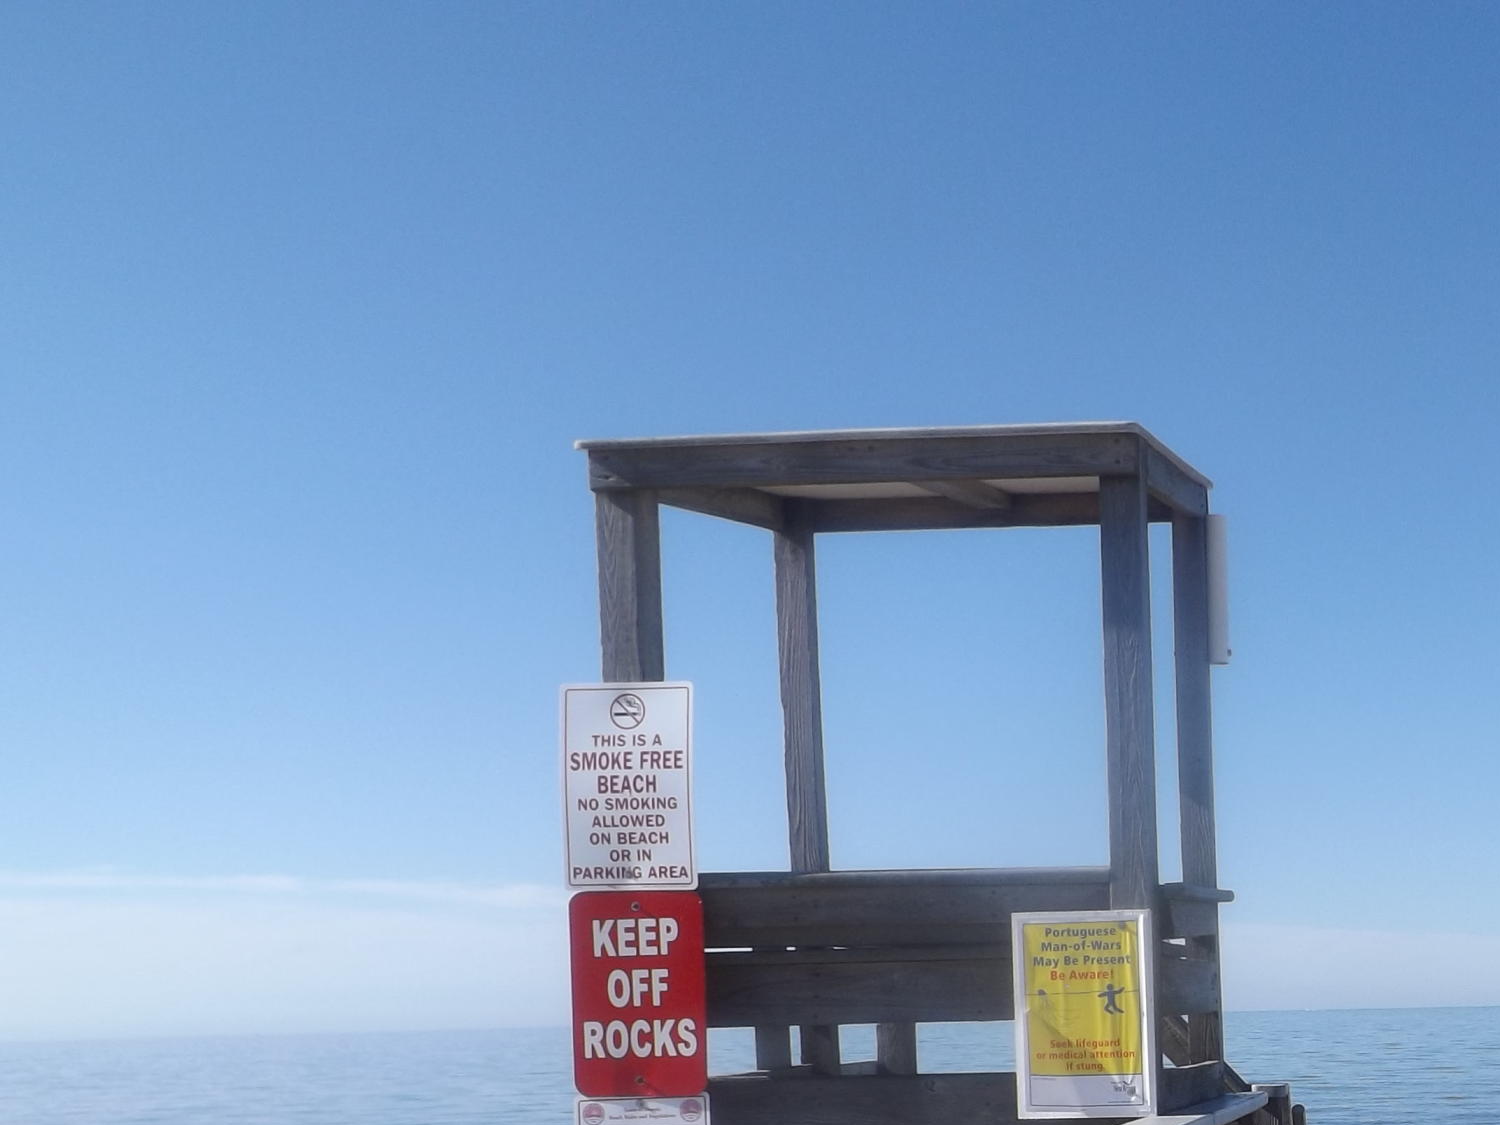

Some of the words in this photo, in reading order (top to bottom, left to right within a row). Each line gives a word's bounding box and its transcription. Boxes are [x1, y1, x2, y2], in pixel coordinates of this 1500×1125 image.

[592, 734, 626, 747] THIS
[632, 734, 647, 747] IS
[652, 734, 662, 746] A
[570, 751, 633, 771] SMOKE
[640, 750, 684, 770] FREE
[597, 774, 657, 794] BEACH
[578, 798, 599, 811] NO
[605, 797, 677, 810] SMOKING
[592, 815, 665, 828] ALLOWED
[589, 832, 611, 845] ON
[617, 832, 669, 845] BEACH
[609, 849, 631, 862] OR
[637, 849, 652, 861] IN
[648, 866, 689, 879] AREA
[592, 917, 679, 958] KEEP
[1044, 926, 1116, 939] Portuguese
[1041, 940, 1122, 952] Man-of-Wars
[1033, 956, 1059, 969] May
[1064, 955, 1078, 966] Be
[1083, 954, 1131, 965] Present
[1050, 971, 1065, 981] Be
[1069, 969, 1114, 980] Aware!
[607, 968, 669, 1008] OFF
[583, 1018, 697, 1059] ROCKS
[1050, 1039, 1073, 1049] Seek
[1076, 1039, 1120, 1049] lifeguard
[1036, 1052, 1046, 1060] or
[1049, 1050, 1087, 1060] medical
[1090, 1050, 1136, 1059] attention
